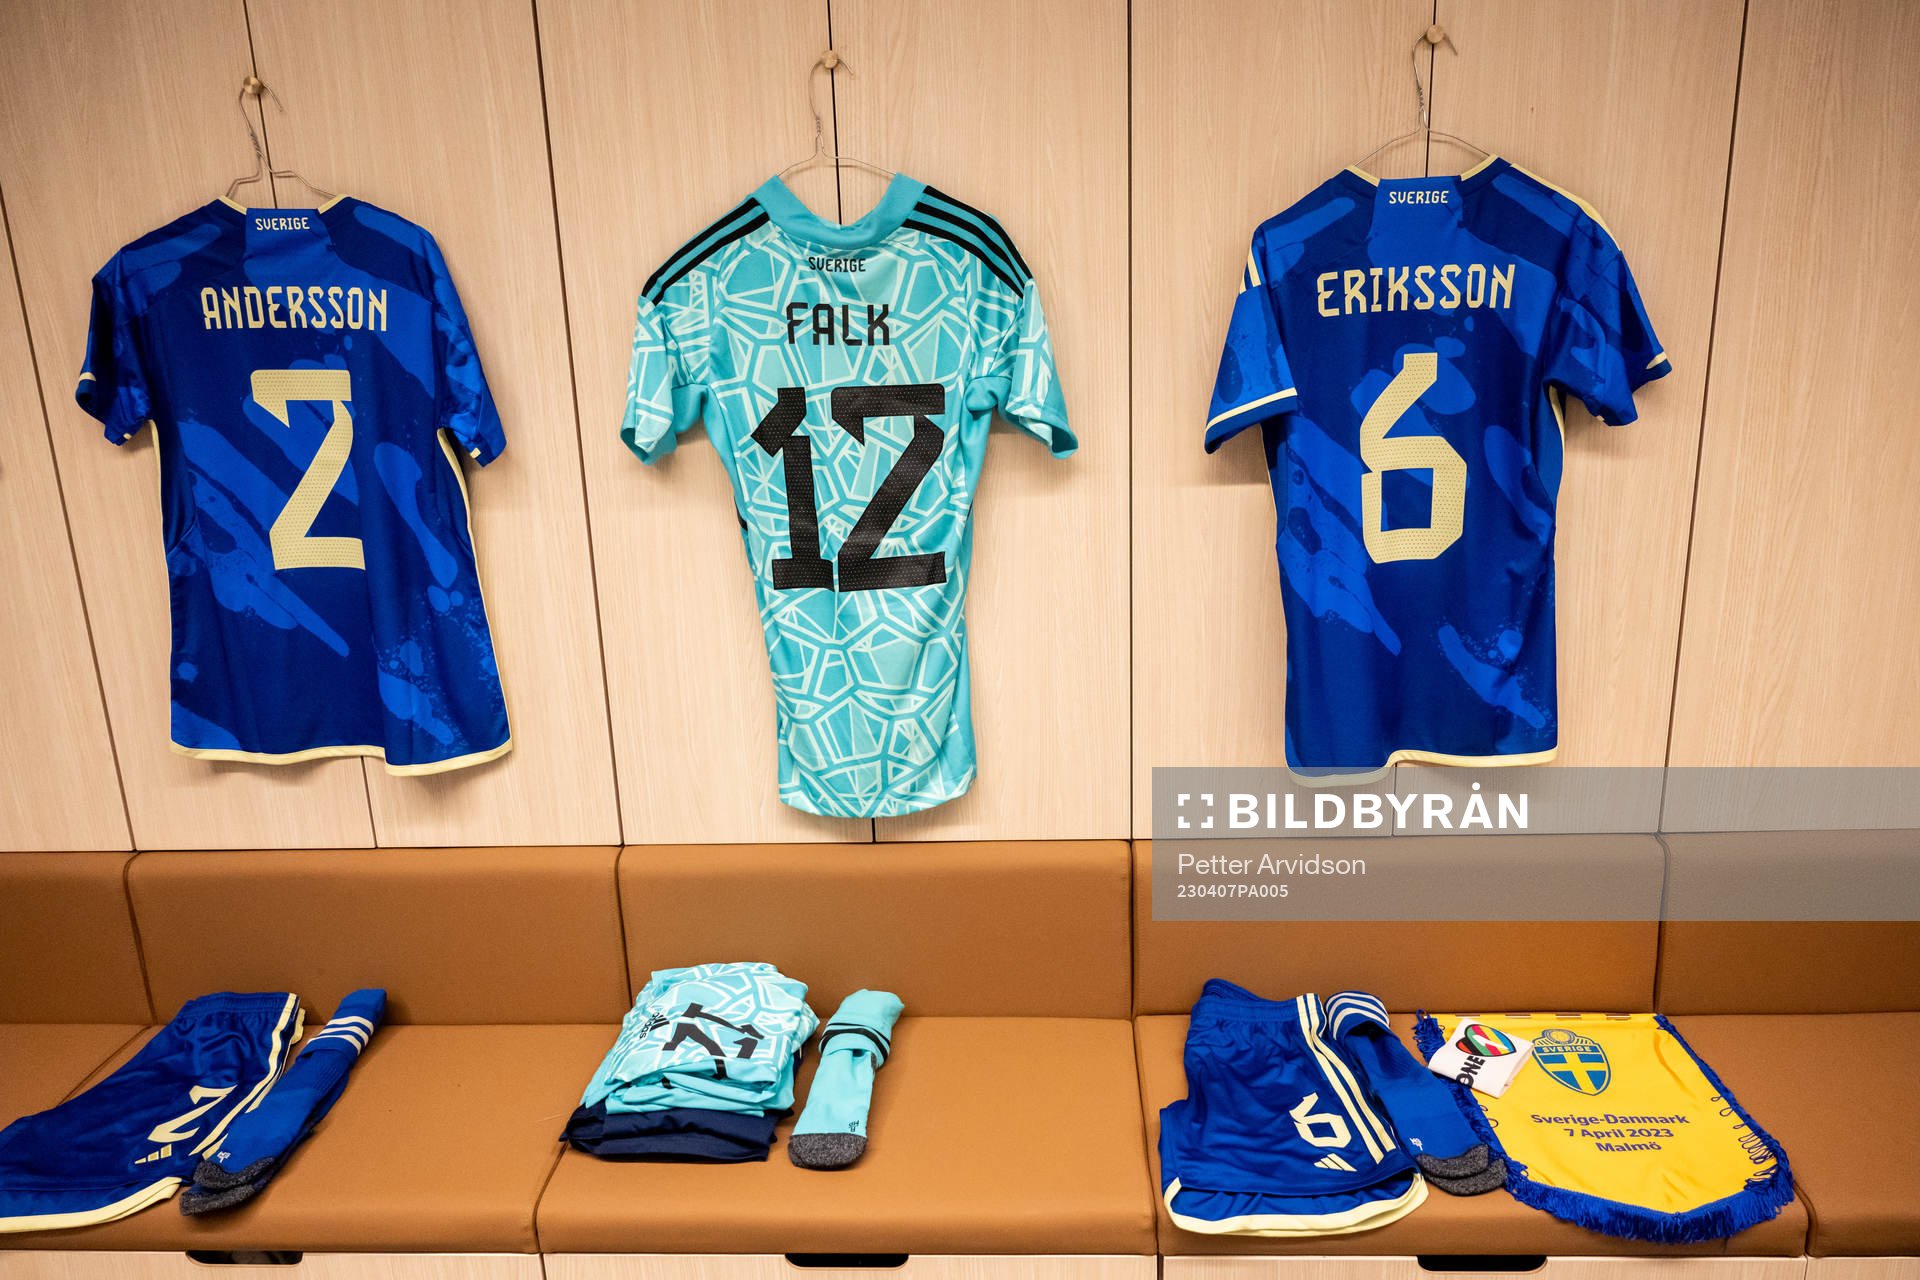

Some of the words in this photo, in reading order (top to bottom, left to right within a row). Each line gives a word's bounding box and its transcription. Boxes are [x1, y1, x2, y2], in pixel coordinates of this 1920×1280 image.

[1388, 189, 1450, 205] SVERIGE
[255, 217, 311, 231] SVERIGE
[808, 256, 867, 274] SVERIGE
[200, 286, 388, 332] ANDERSSON
[1316, 263, 1516, 318] ERIKSSON
[785, 302, 891, 347] FALK
[250, 368, 366, 571] 2
[1359, 352, 1468, 564] 6
[750, 383, 948, 593] 12
[1541, 1045, 1593, 1053] SVERIGE
[147, 1084, 238, 1144] 2
[1289, 1092, 1352, 1148] 6
[1530, 1113, 1691, 1127] Sverige-Danmark
[1563, 1128, 1575, 1137] 7
[1581, 1128, 1626, 1140] April
[1626, 1128, 1675, 1138] 2023
[1595, 1141, 1663, 1152] Malmö
